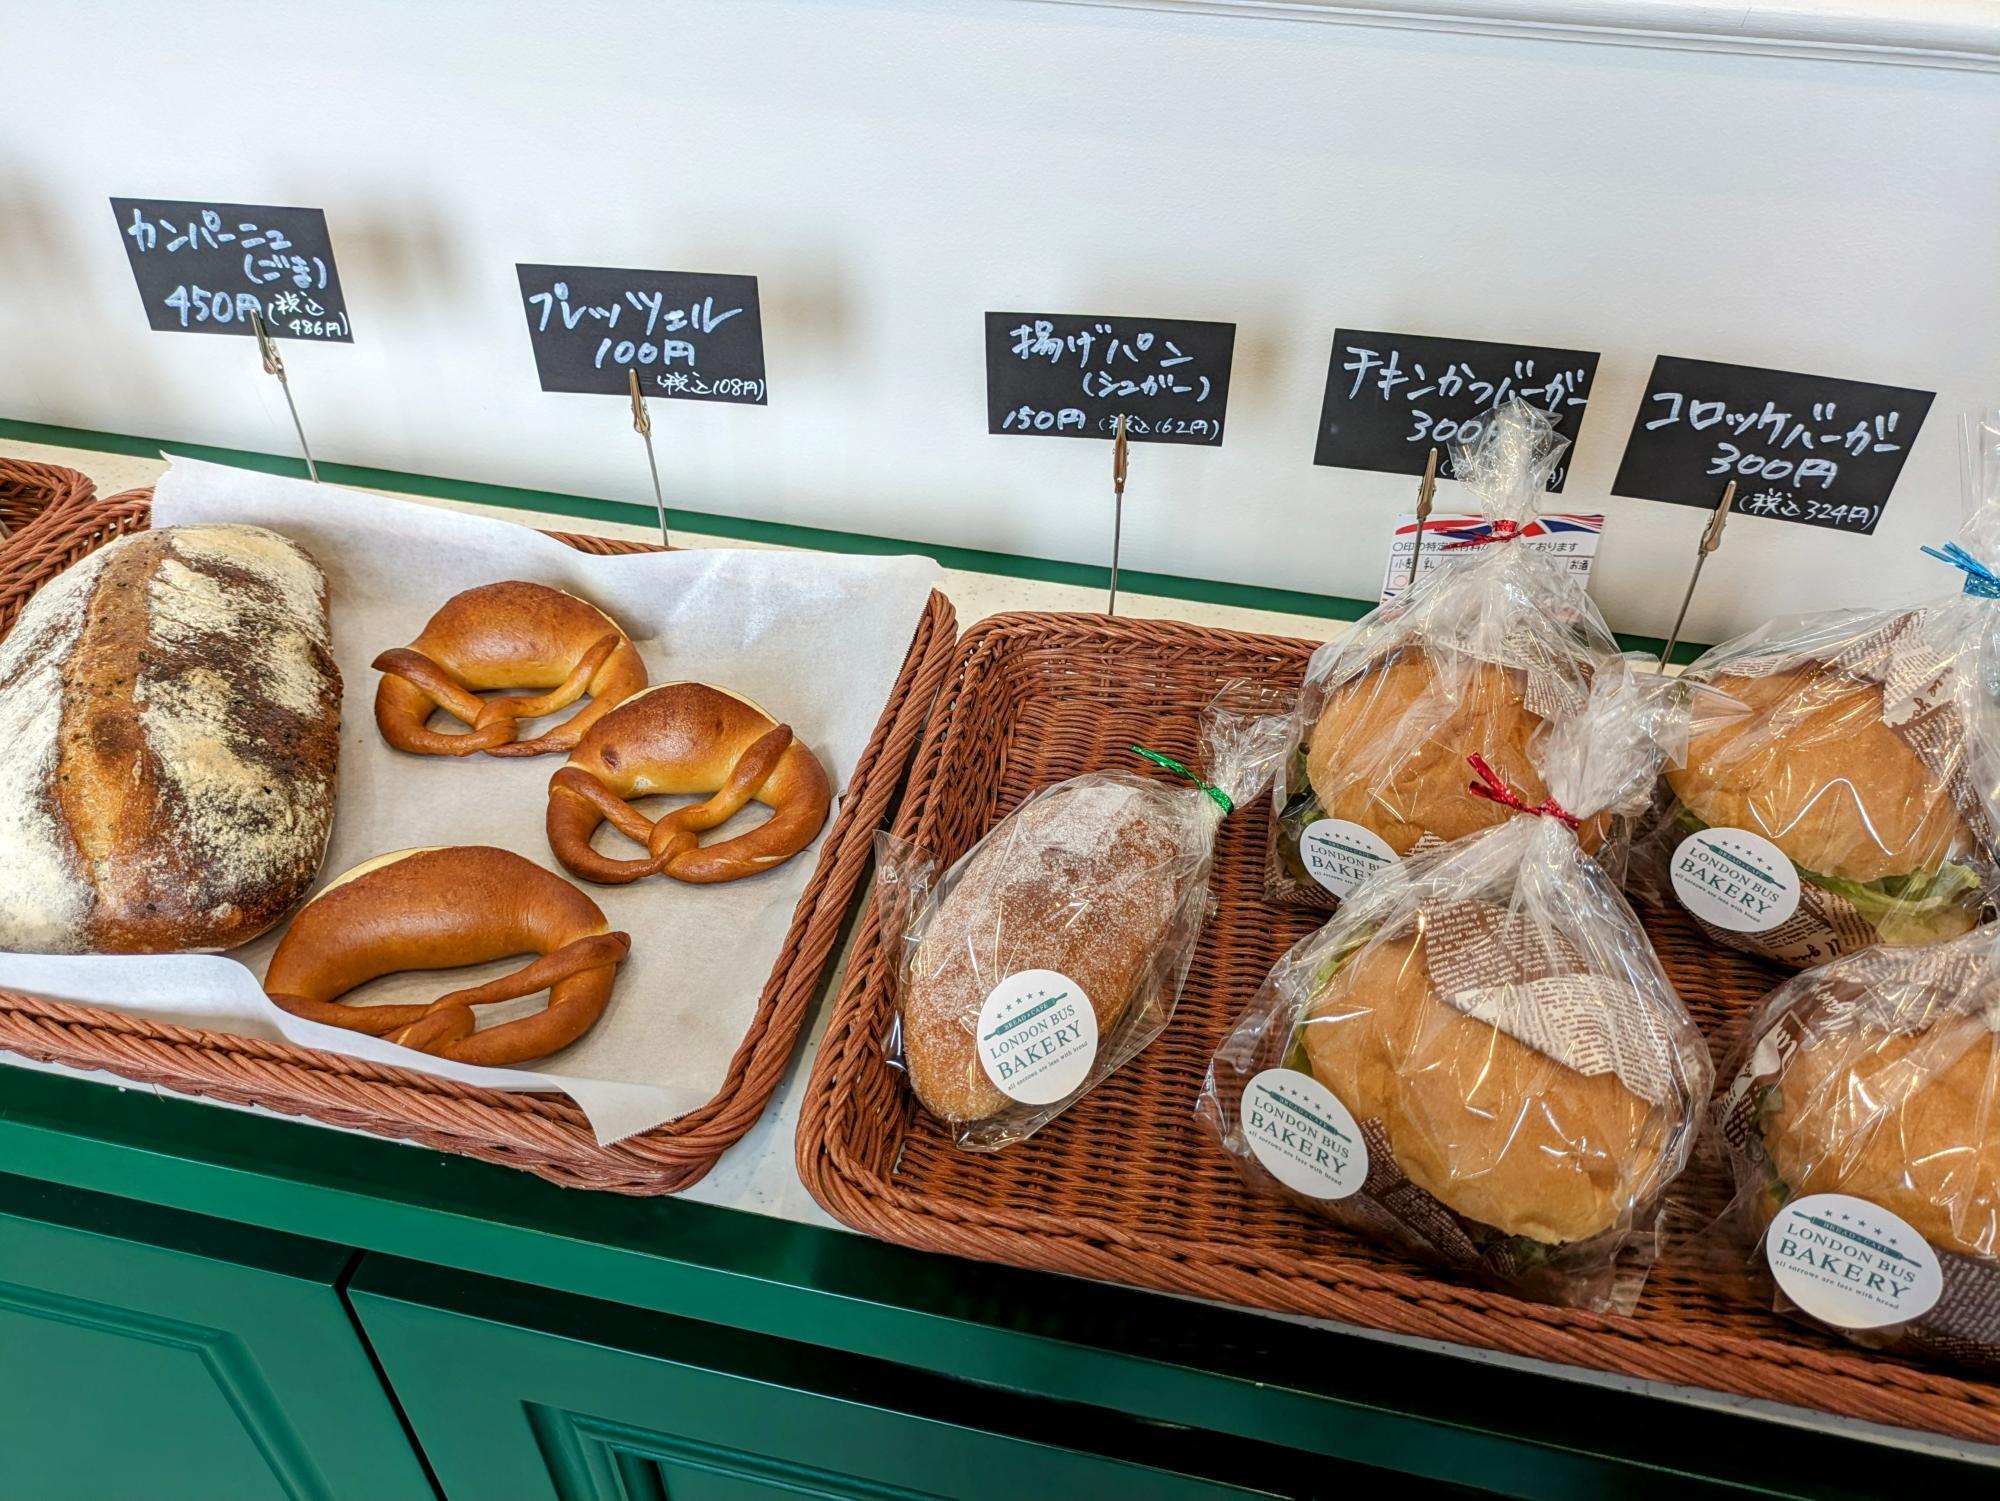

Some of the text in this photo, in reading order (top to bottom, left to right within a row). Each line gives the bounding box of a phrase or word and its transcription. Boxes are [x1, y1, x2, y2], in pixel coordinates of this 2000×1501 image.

[128, 208, 292, 252] カンパーニュ
[243, 254, 327, 290] (ごま)
[164, 285, 263, 328] 450円
[528, 281, 743, 337] プレッツェル
[595, 338, 695, 369] 100円
[1009, 320, 1195, 368] 揚げパン
[656, 371, 765, 401] (税込108円)
[1082, 370, 1211, 403] (シュガー)
[1343, 346, 1590, 412] チキンかつバーガー
[1002, 405, 1086, 431] 150円
[1645, 392, 1901, 457] コロッケバーガー
[1706, 441, 1838, 489] 300円
[1738, 487, 1880, 530] (税込324円)
[1311, 844, 1365, 867] LONDON
[1312, 855, 1371, 880] BAKE
[1689, 847, 1780, 903] LONDON BUS
[1679, 857, 1772, 915] BAKERY
[990, 1004, 1076, 1060] LONDON BUS
[996, 1019, 1082, 1081] BAKERY
[1249, 1109, 1348, 1175] BAKERY
[1254, 1096, 1350, 1159] LONDON BUS
[1787, 1223, 1916, 1283] LONDON BUS
[1823, 1221, 1857, 1239] BREAD
[1778, 1238, 1911, 1299] BAKERY
[1789, 1265, 1819, 1279] sorrows
[1837, 1281, 1853, 1292] less
[1855, 1290, 1873, 1300] with
[1876, 1296, 1899, 1309] bread
